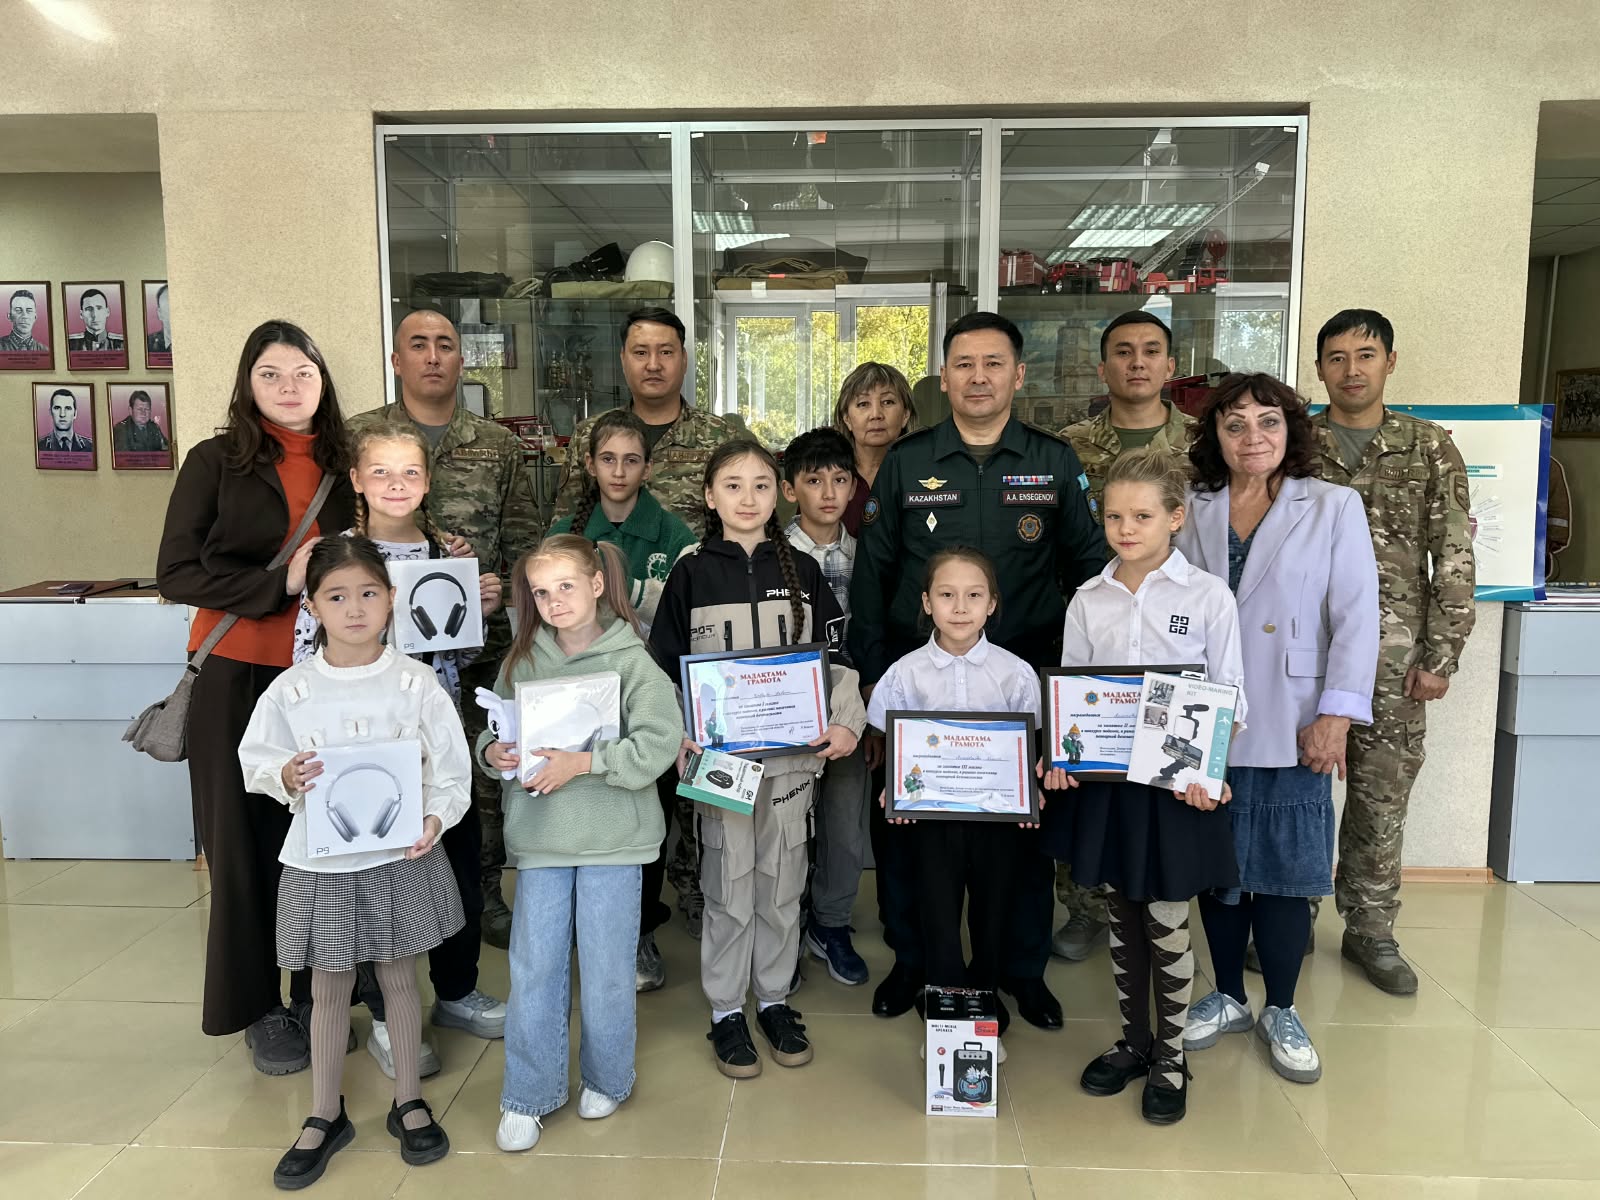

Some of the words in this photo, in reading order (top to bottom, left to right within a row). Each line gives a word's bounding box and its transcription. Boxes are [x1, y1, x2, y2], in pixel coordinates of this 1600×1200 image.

[908, 493, 958, 502] KAZAKHSTAN
[1006, 493, 1018, 501] A.A.
[1019, 493, 1054, 501] ENSEGENOV
[766, 588, 810, 600] PHEIX
[747, 676, 781, 686] ГРАМОТА
[1188, 684, 1233, 696] VIDEO-MAKING
[772, 779, 811, 806] PHENIX
[316, 847, 330, 856] P9
